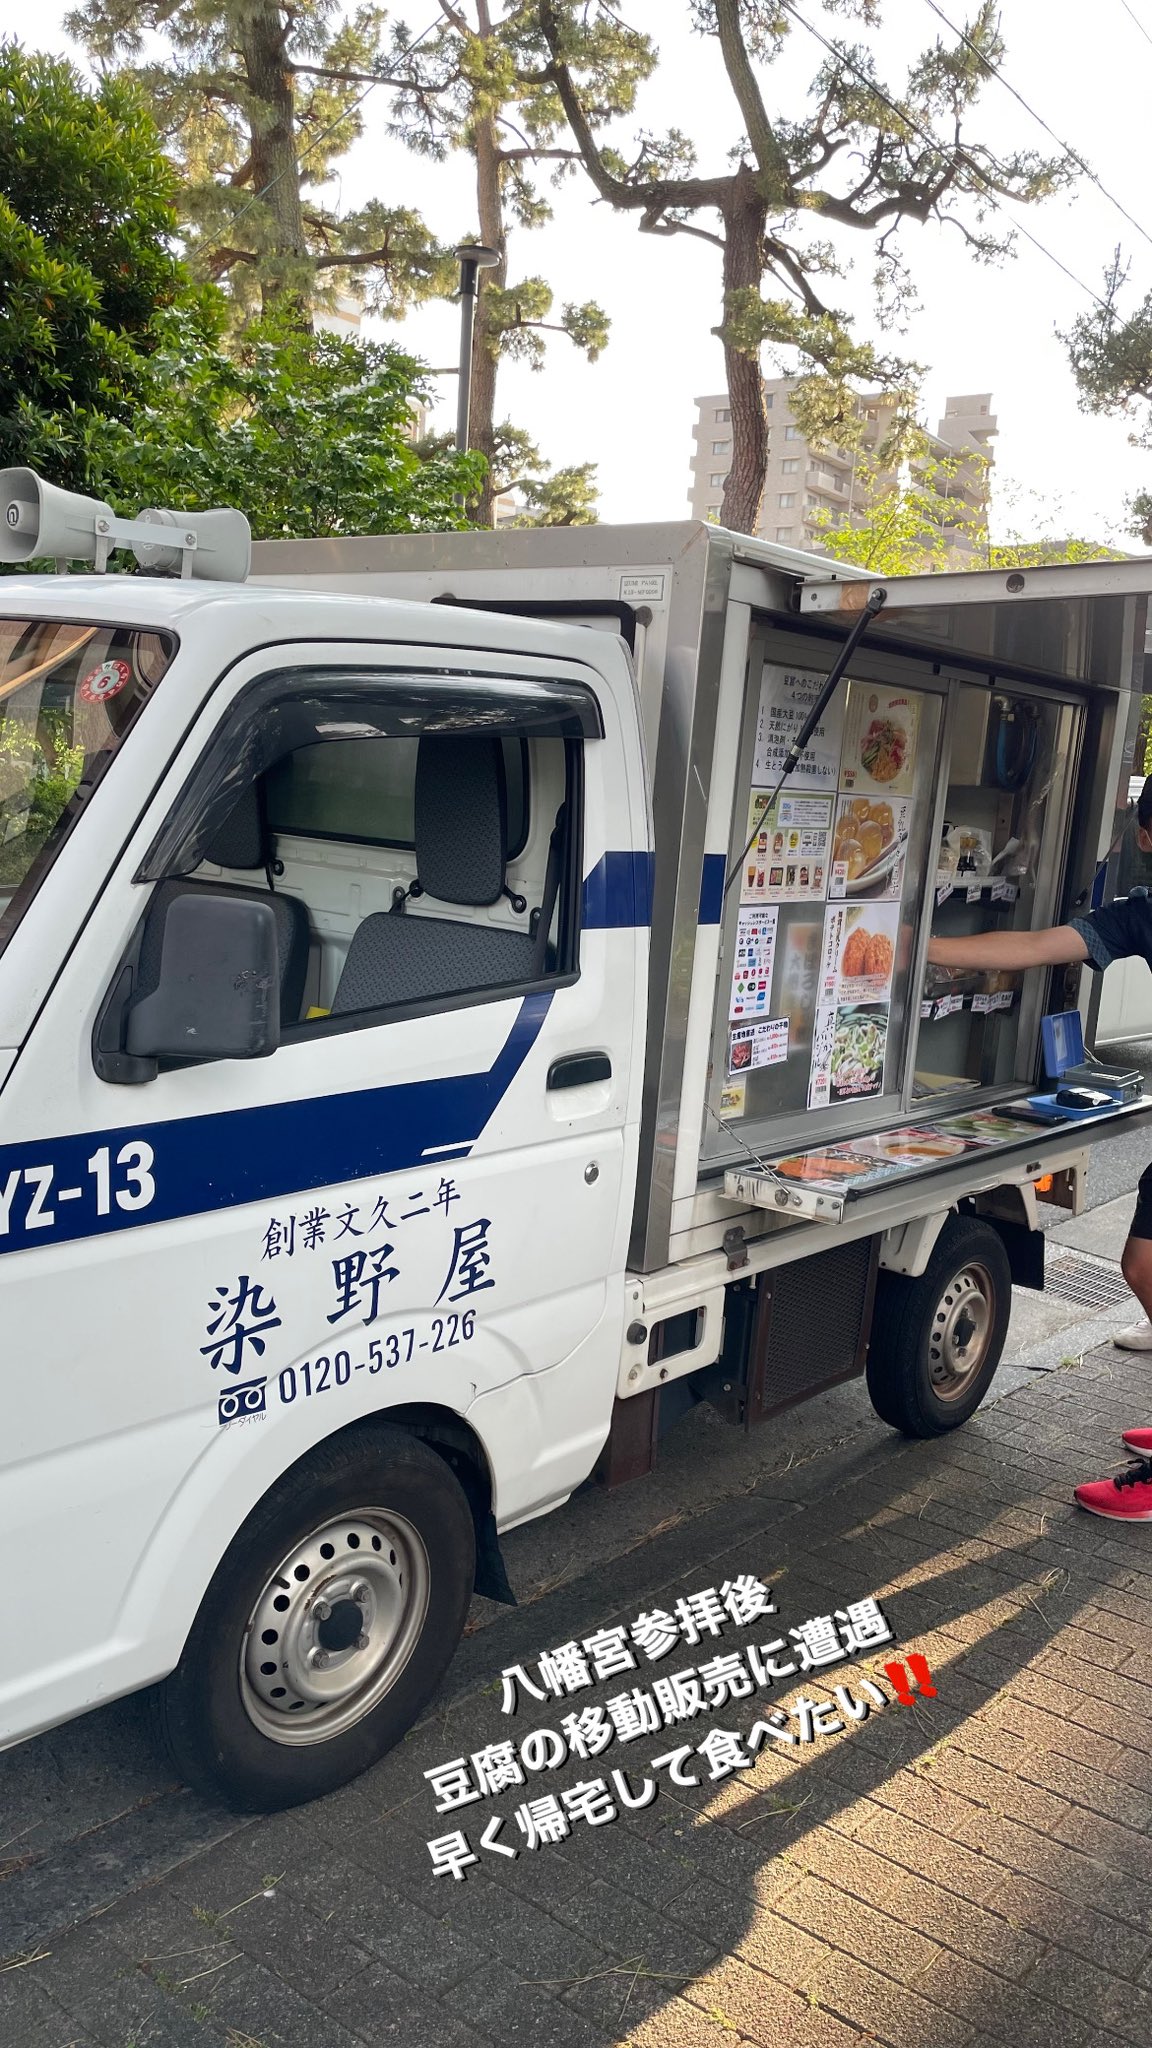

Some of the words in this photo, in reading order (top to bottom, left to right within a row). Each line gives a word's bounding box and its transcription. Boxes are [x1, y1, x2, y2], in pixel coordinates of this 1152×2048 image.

[97, 676, 111, 689] 6
[261, 1177, 461, 1262] 創業文久二年
[278, 1309, 477, 1404] 0120-537-226
